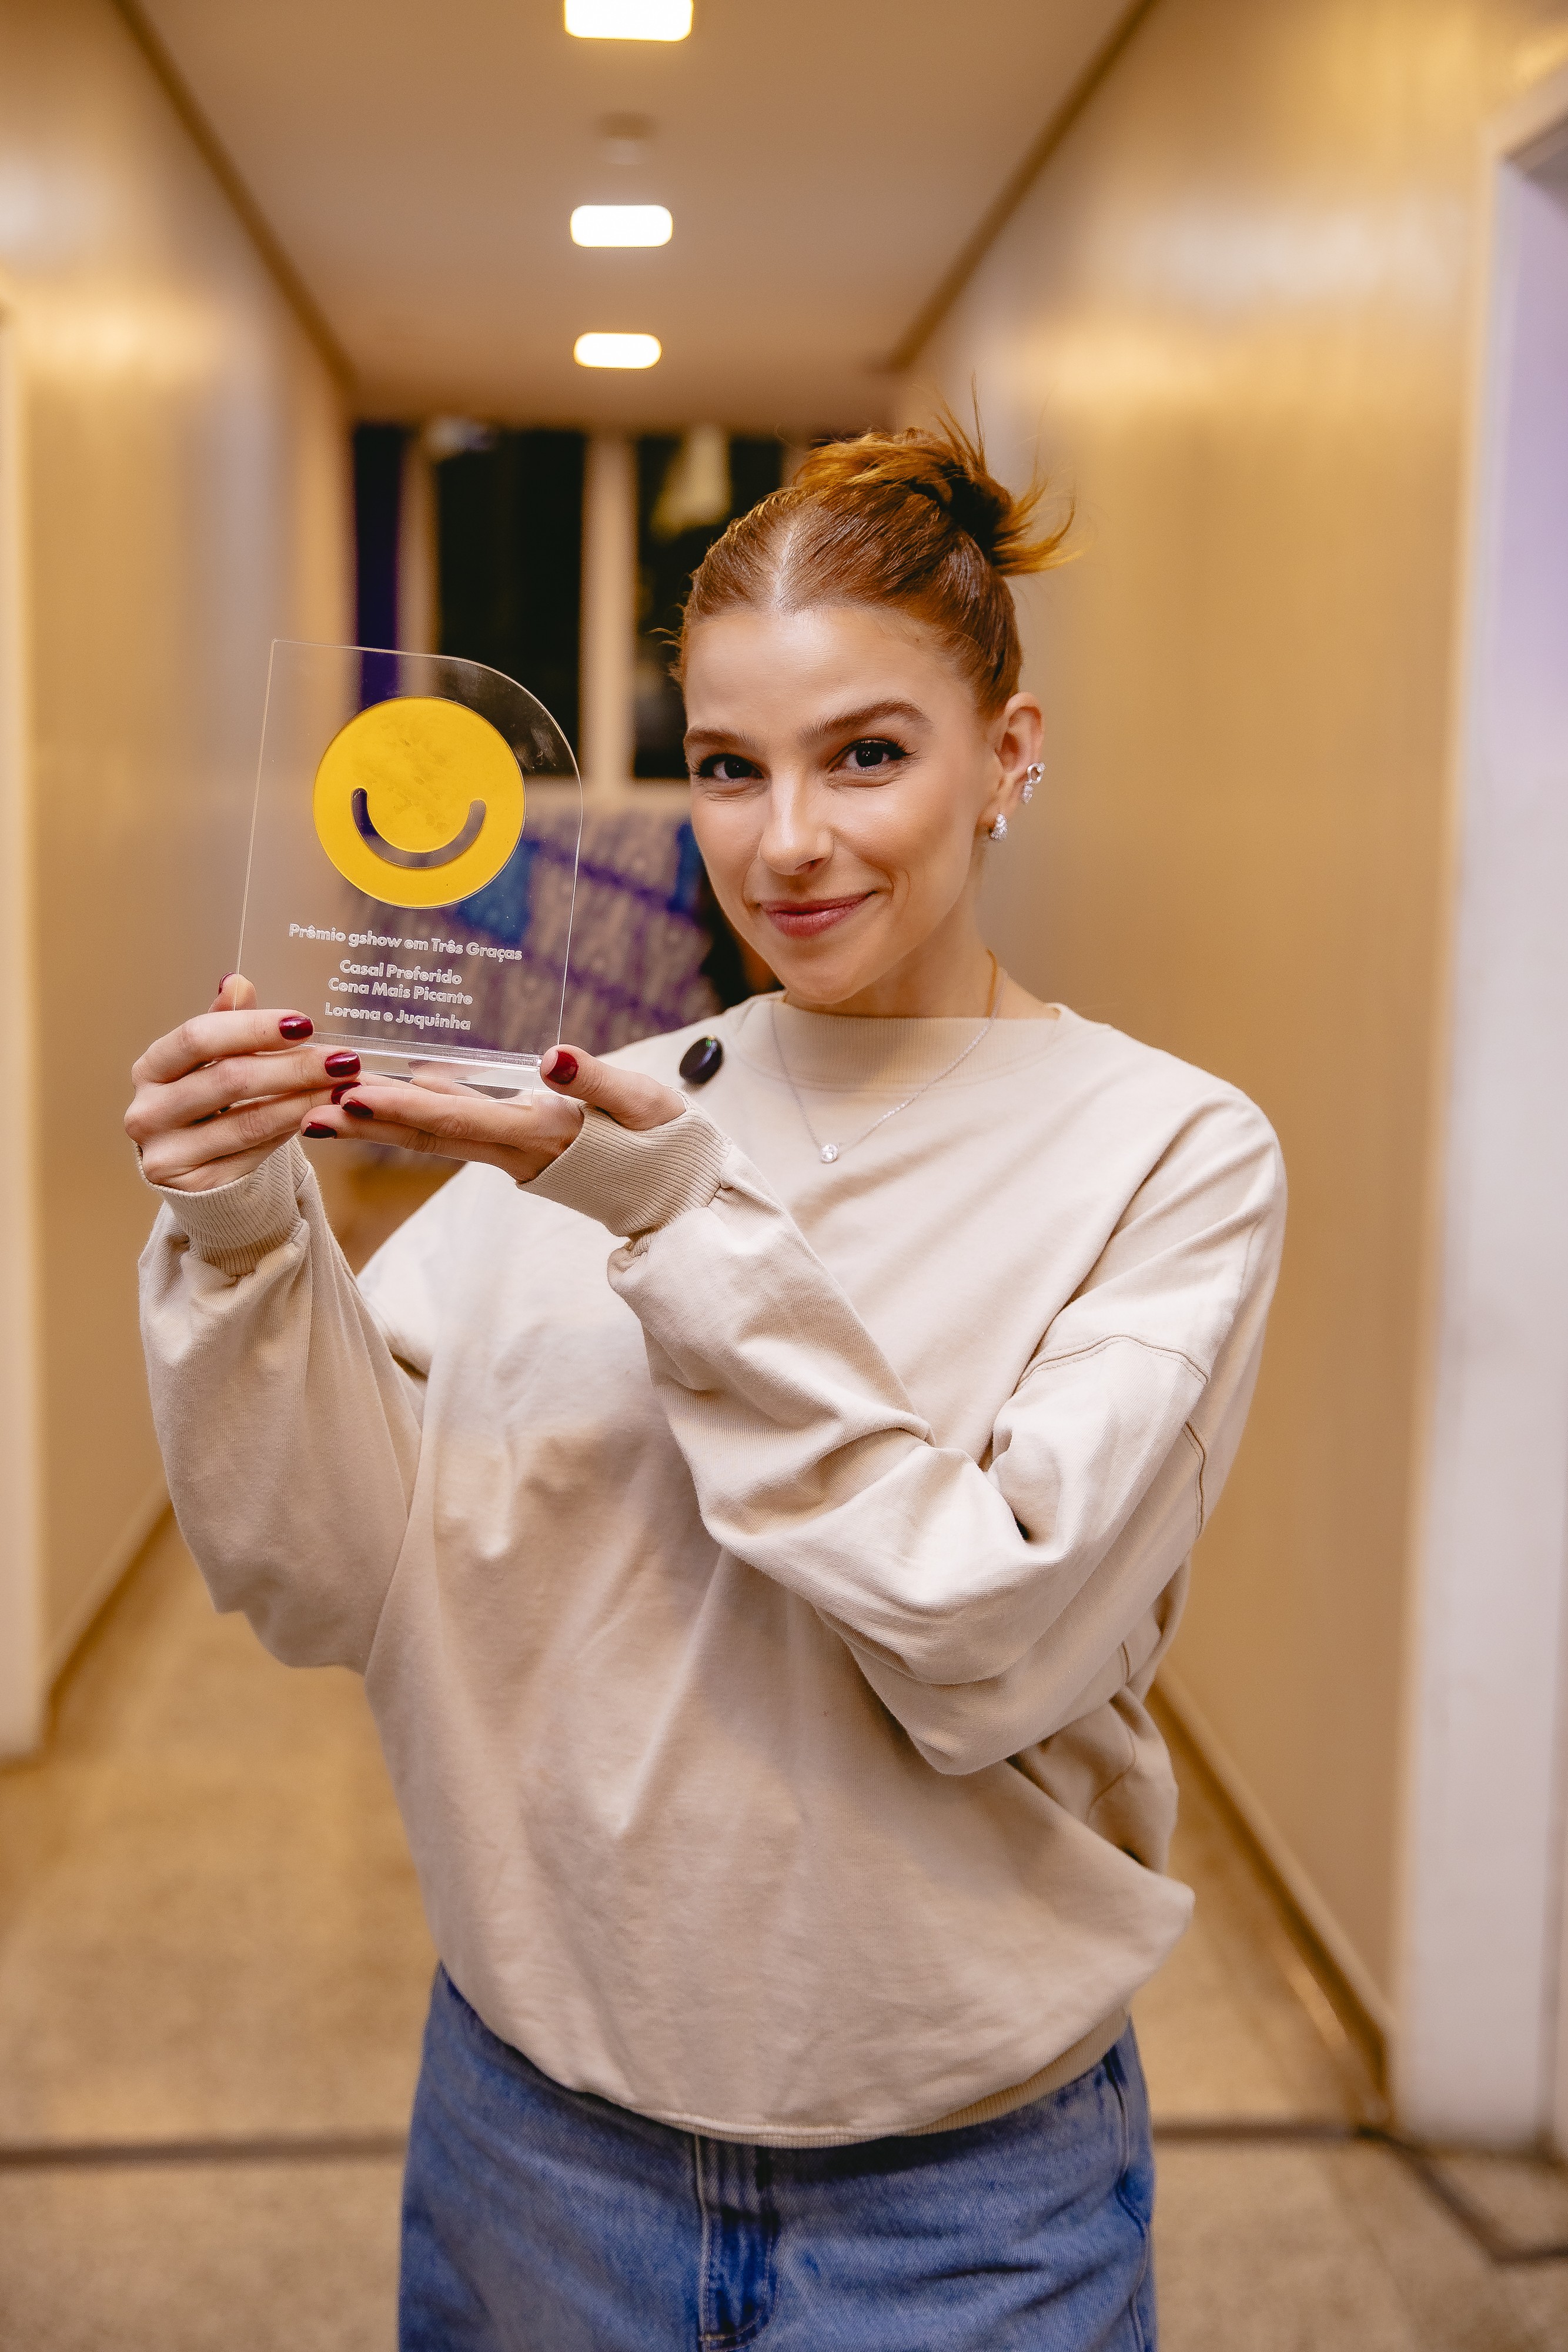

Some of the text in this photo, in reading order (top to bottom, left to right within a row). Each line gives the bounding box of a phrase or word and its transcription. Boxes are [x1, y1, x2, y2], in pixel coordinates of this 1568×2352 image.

[289, 923, 523, 962] Prêmio gshow em Três Graças
[339, 960, 462, 984] Casal Preferido
[328, 978, 473, 1004] Cena Mais Picante
[325, 1003, 471, 1030] Lorena e Juquinha
